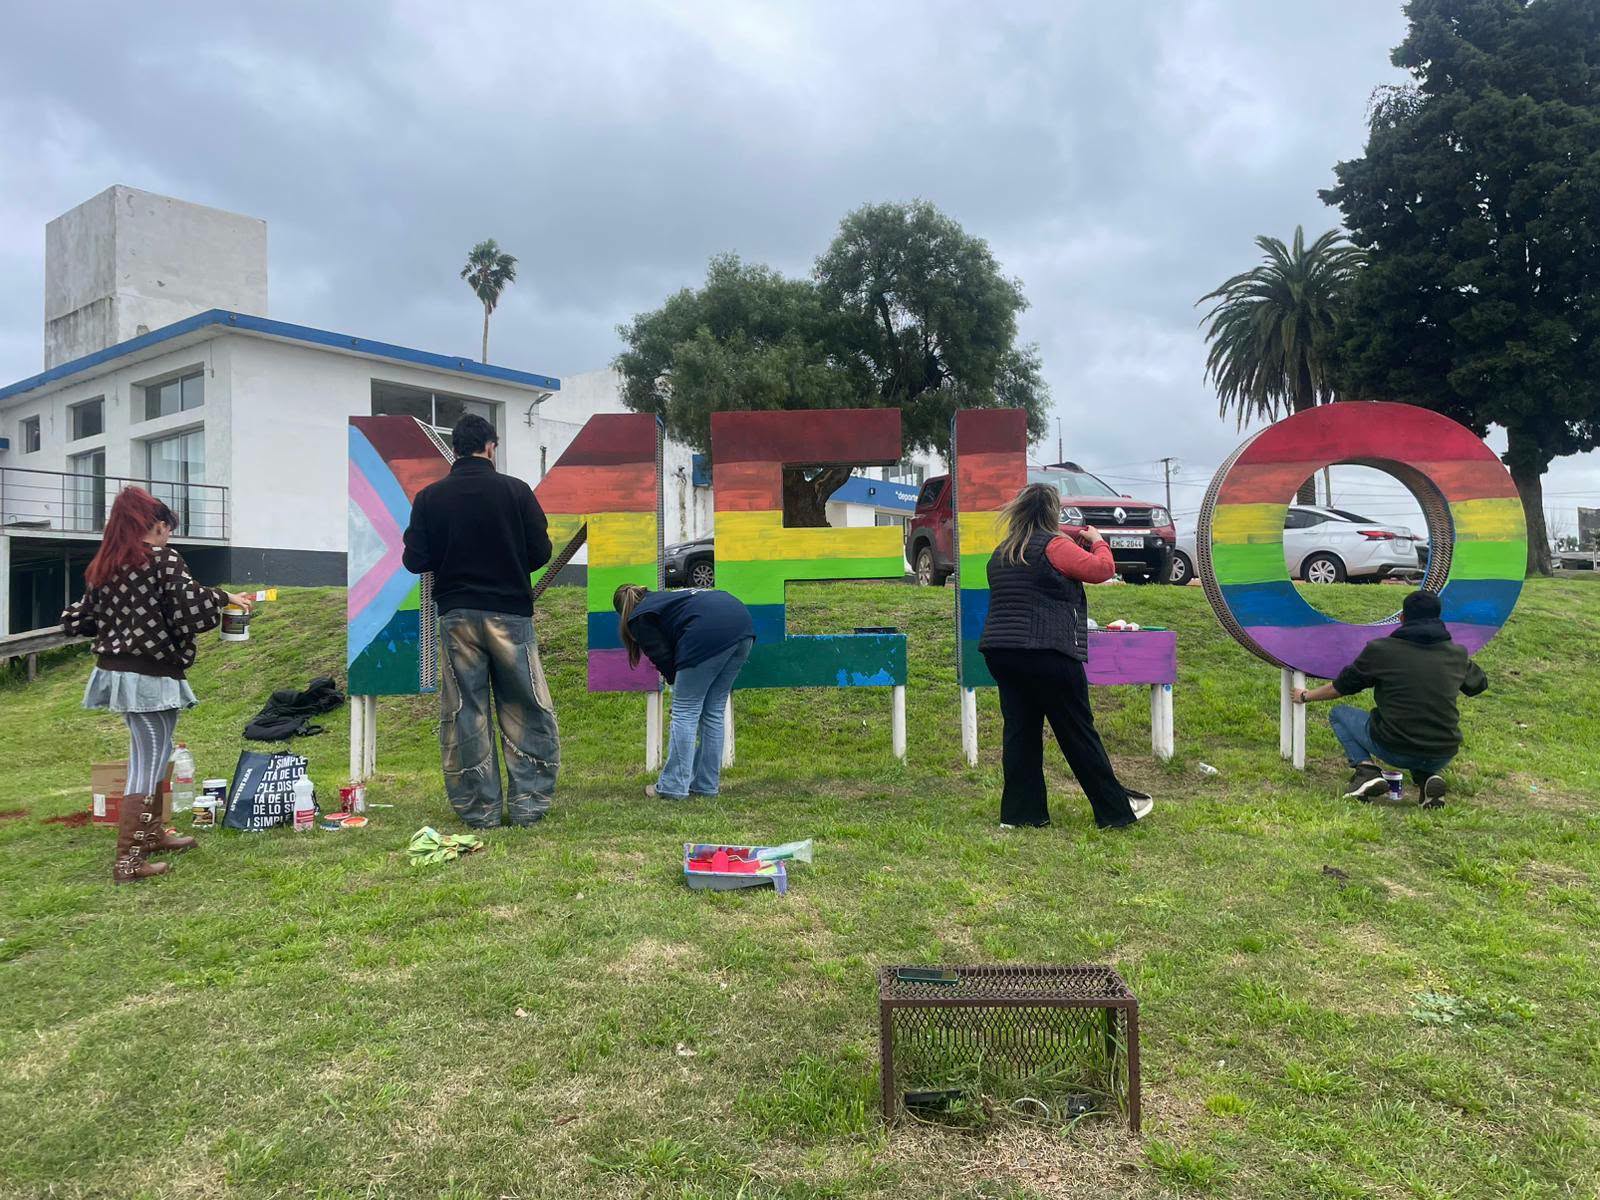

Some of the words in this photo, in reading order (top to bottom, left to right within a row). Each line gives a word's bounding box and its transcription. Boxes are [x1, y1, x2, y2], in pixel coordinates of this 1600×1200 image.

[348, 401, 1527, 694] MELO
[276, 756, 308, 769] SIMPLE
[280, 768, 290, 780] DE
[292, 767, 304, 778] LO
[257, 782, 275, 792] PLE
[268, 793, 280, 804] DE
[284, 793, 296, 803] LO
[253, 805, 266, 815] DE
[269, 804, 281, 815] LO
